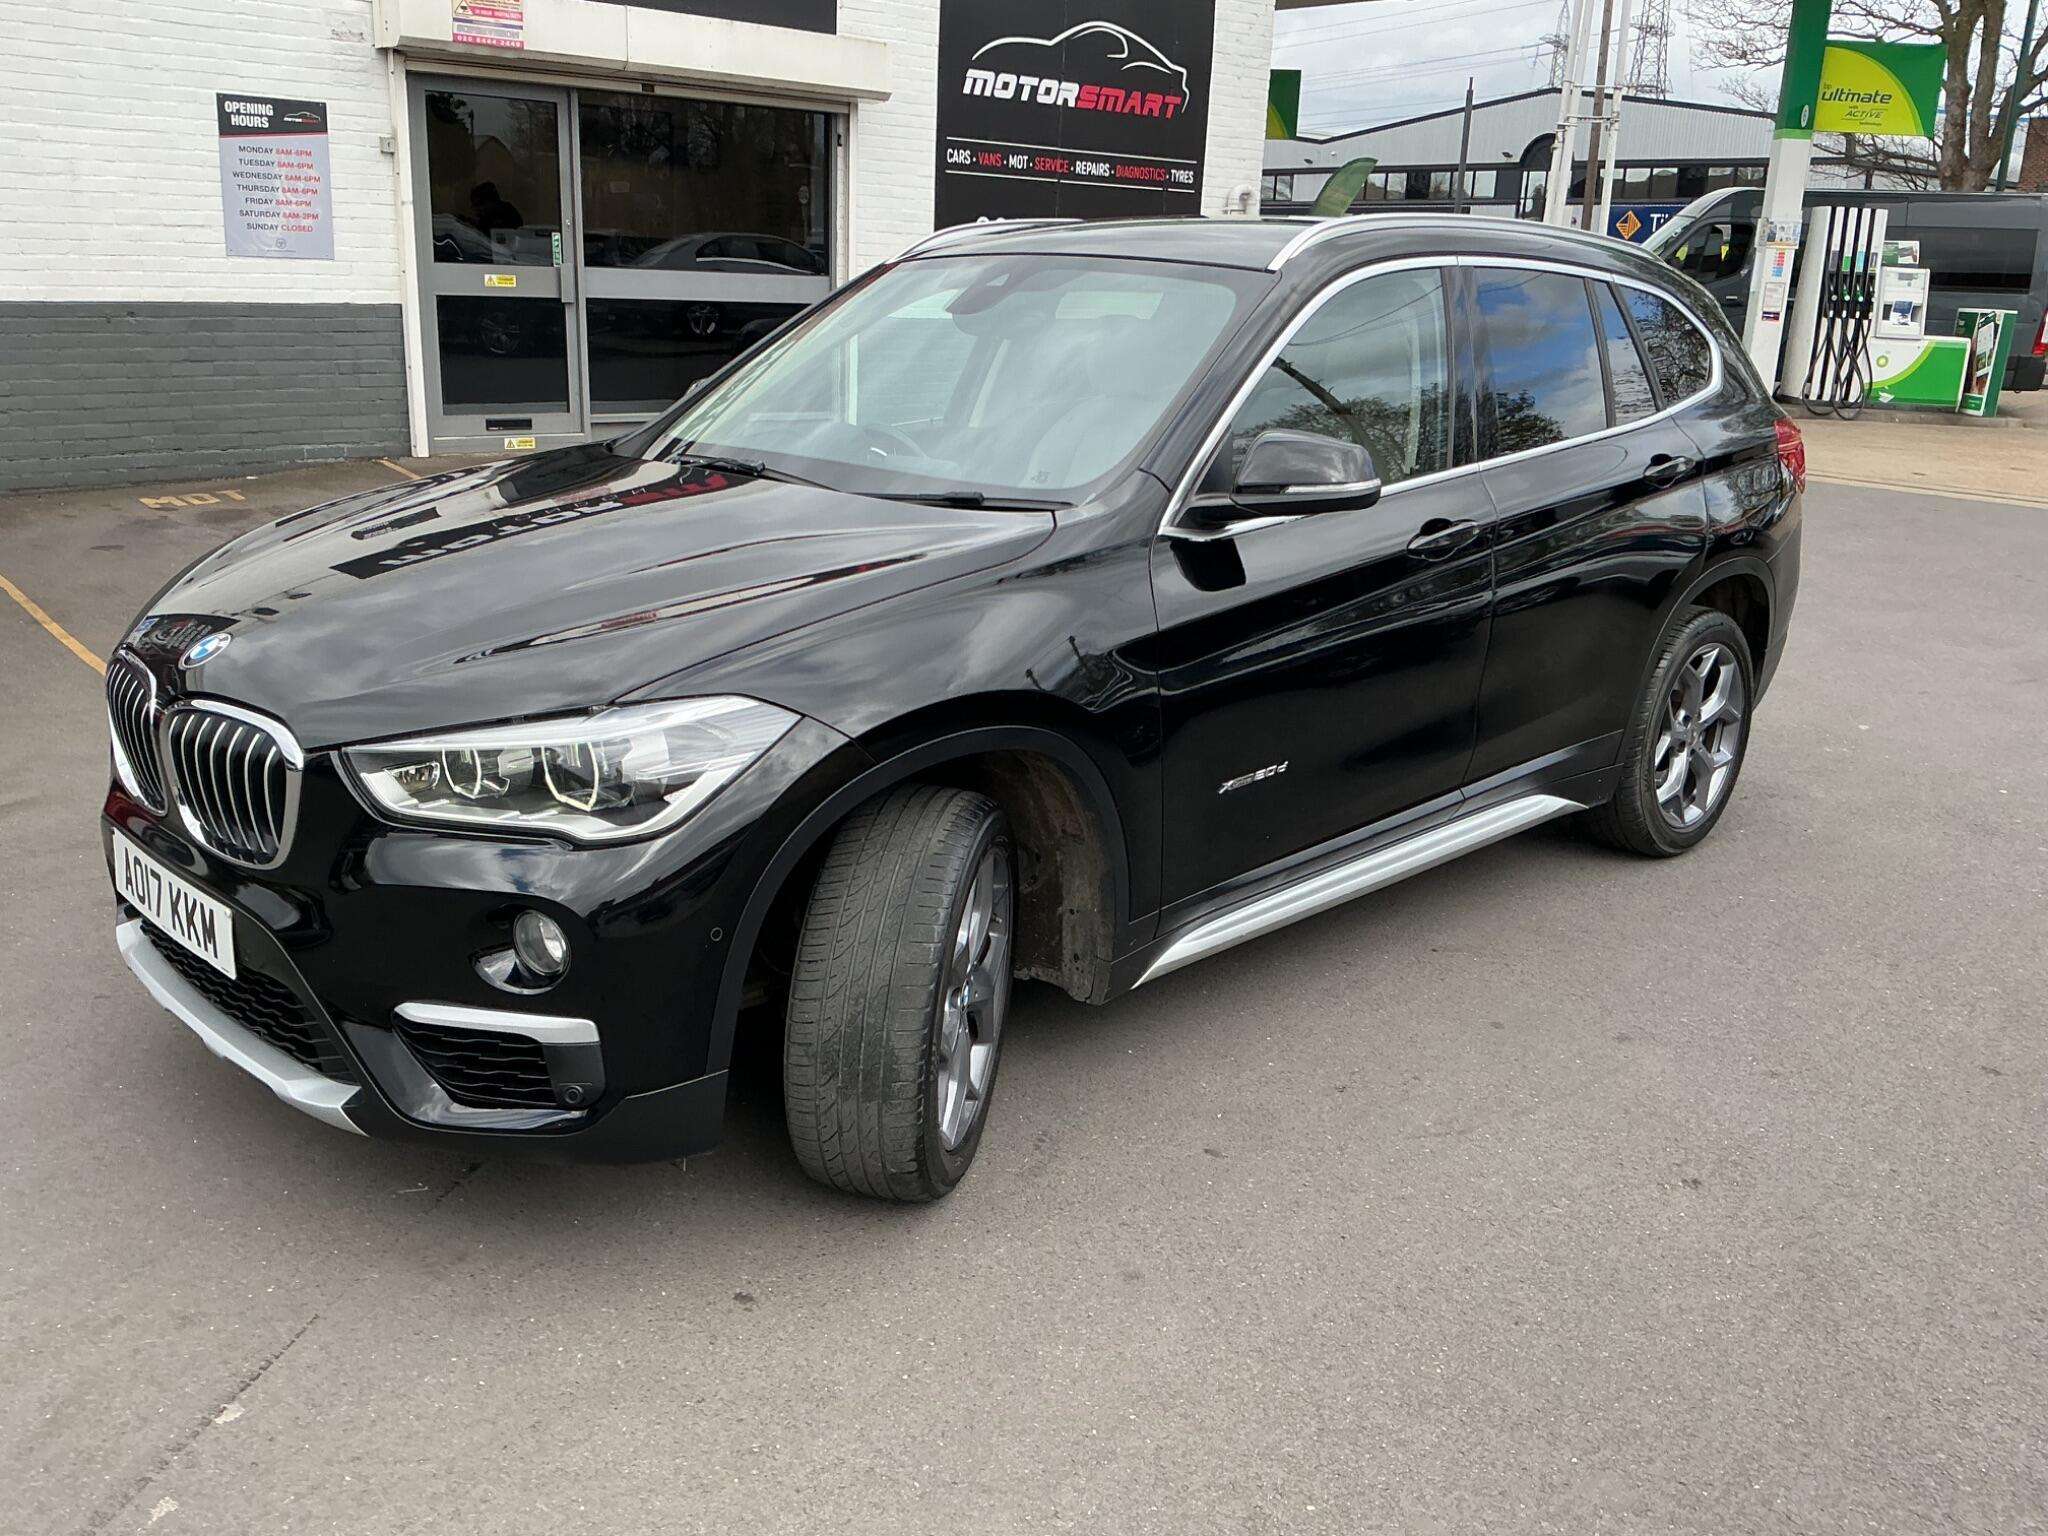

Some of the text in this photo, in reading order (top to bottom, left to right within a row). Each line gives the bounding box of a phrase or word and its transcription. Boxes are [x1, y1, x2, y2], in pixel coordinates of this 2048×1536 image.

[962, 68, 1183, 119] MOTORSMART
[1821, 87, 1893, 104] ultimate
[224, 100, 274, 116] OPENING
[1844, 109, 1884, 119] ACTIVE
[230, 114, 270, 128] HOURS
[238, 145, 274, 155] MONDAY
[238, 158, 275, 167] TUESDAY
[946, 148, 1194, 184] CARS VANS MOT SERVICE REPAIRS DIAGNOSTICS TYRES
[232, 171, 282, 181] WEDNESDAY
[236, 184, 280, 193] THURSDAY
[245, 197, 274, 206] FRIDAY
[239, 209, 281, 219] SATURDAY
[246, 223, 313, 233] SUNDAY CLOSED
[138, 488, 246, 509] MOT
[124, 847, 219, 960] AO17 KKM
